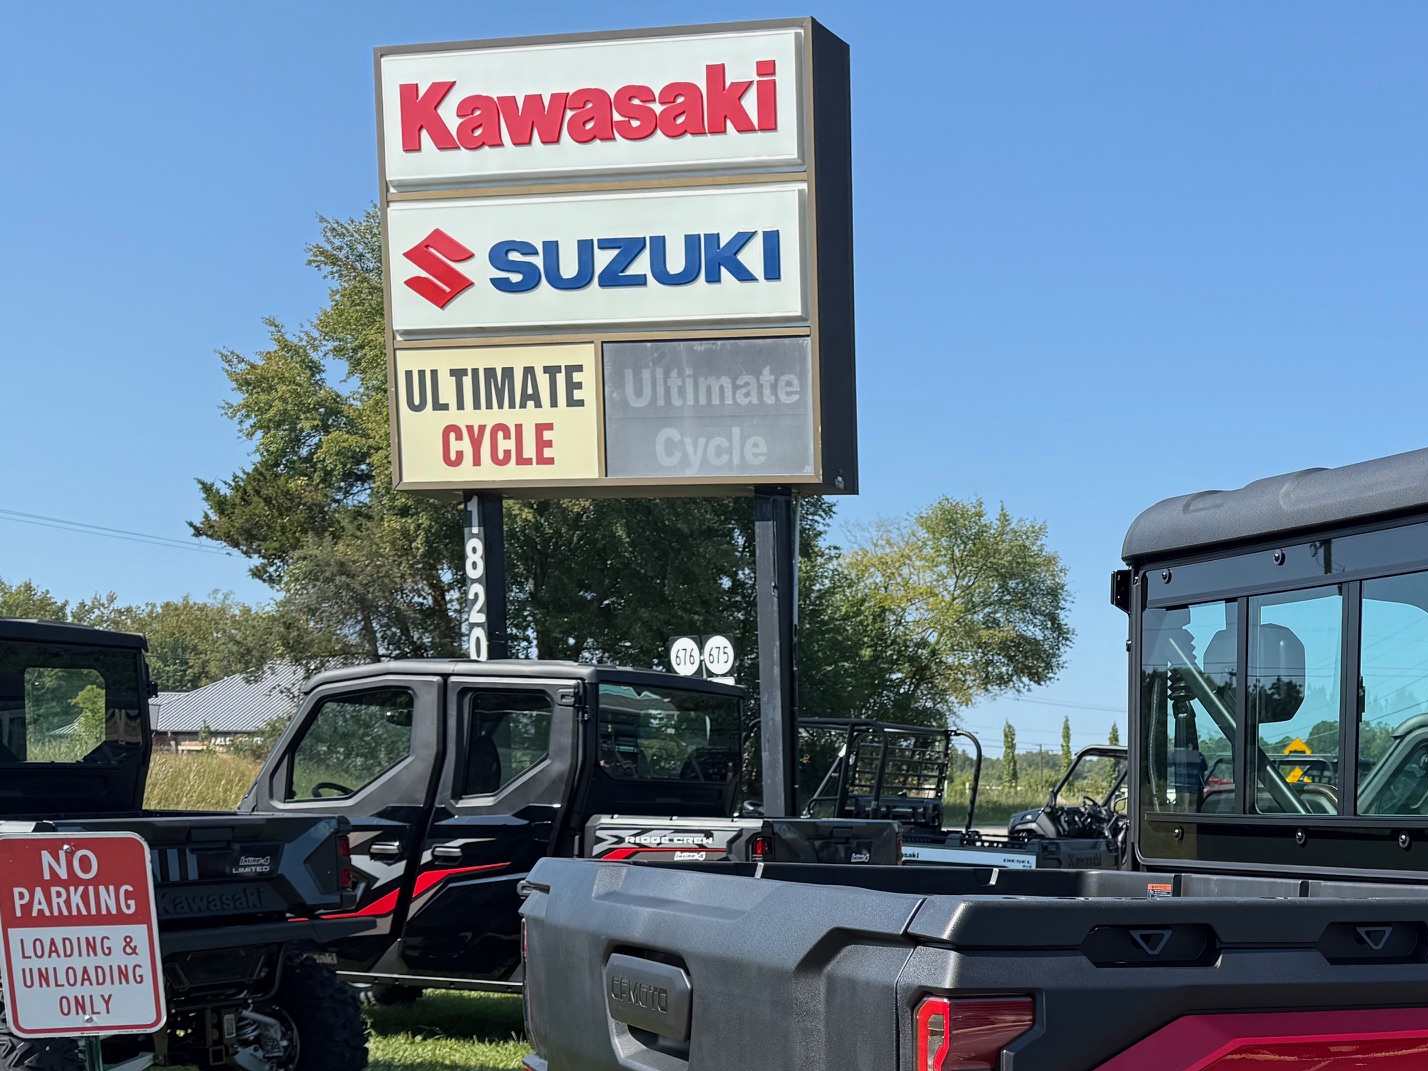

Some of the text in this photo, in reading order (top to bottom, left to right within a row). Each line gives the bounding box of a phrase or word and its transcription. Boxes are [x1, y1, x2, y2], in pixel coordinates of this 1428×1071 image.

[399, 60, 777, 152] Kawasaki
[488, 229, 782, 293] SUZUKI
[404, 364, 585, 412] ULTIMATE
[623, 365, 801, 408] Ultimate
[441, 422, 555, 467] CYCLE
[654, 426, 768, 473] Cycle
[675, 648, 695, 666] 676
[708, 646, 729, 664] 675
[624, 836, 714, 845] RIDGE CREW
[41, 849, 98, 880] NO
[232, 865, 270, 873] LIMITED
[13, 885, 136, 917] PARKING
[159, 886, 264, 915] Kawasaki
[20, 935, 139, 960] LOADING &
[21, 964, 144, 989] UNLOADING
[59, 994, 113, 1016] ONLY
[611, 975, 668, 1014] CFMOTO
